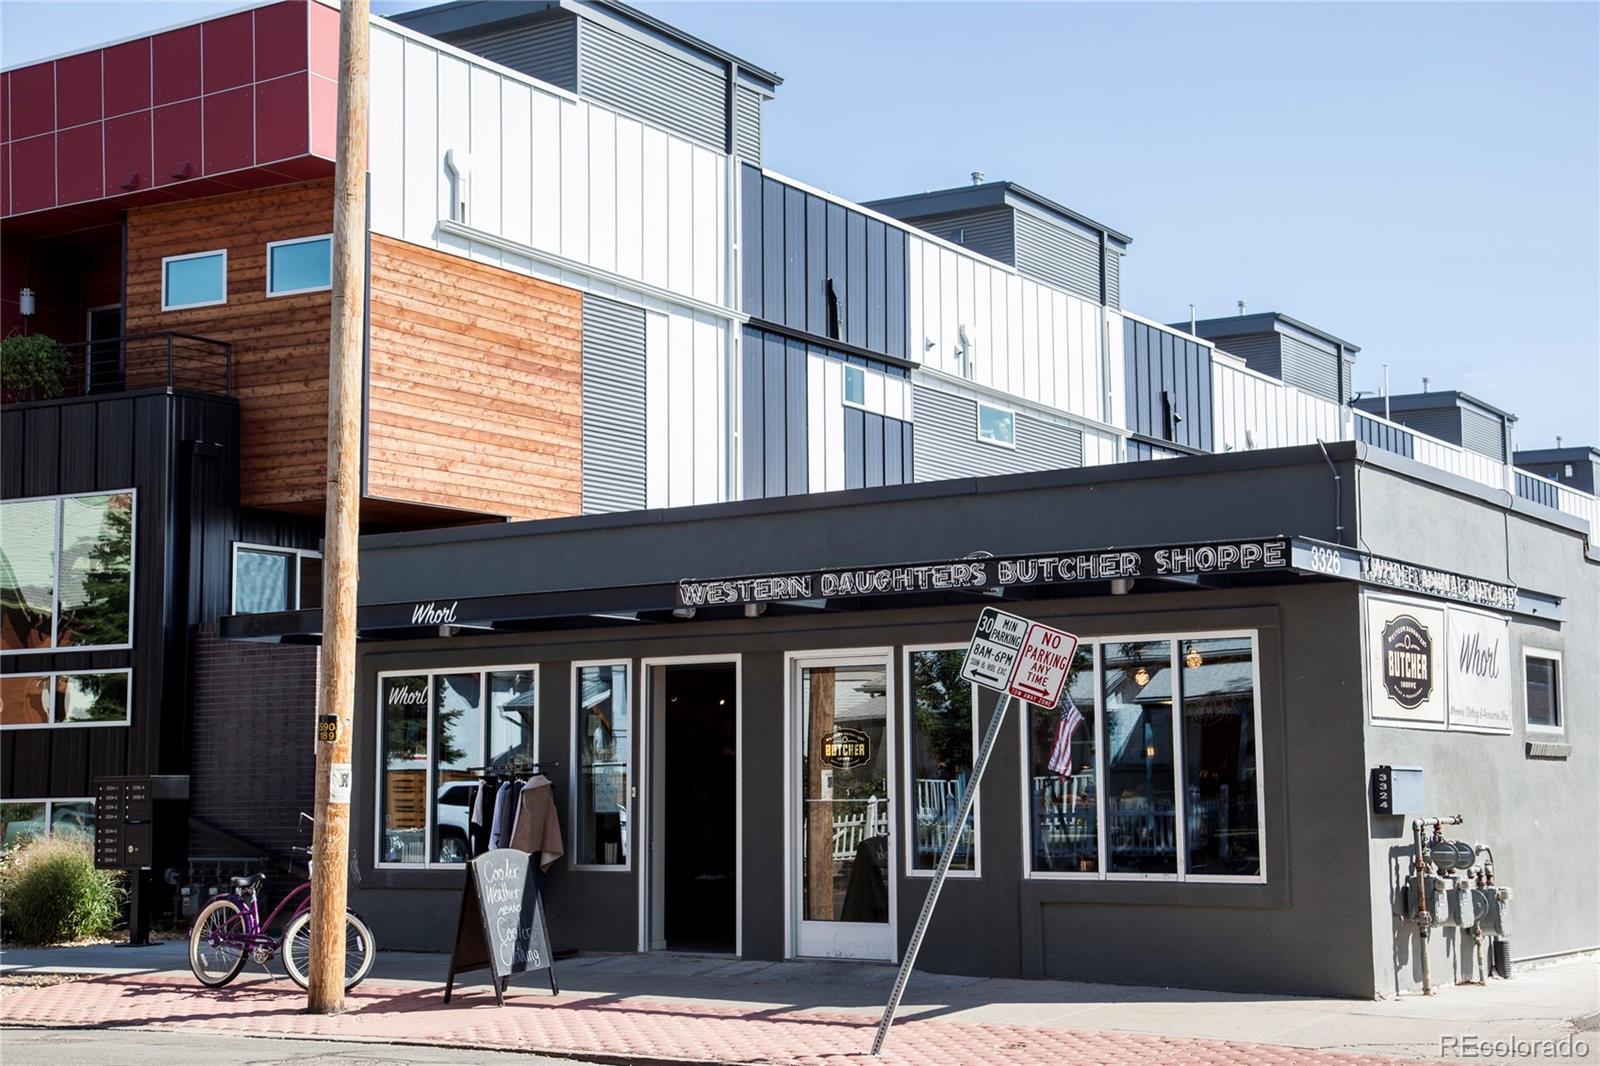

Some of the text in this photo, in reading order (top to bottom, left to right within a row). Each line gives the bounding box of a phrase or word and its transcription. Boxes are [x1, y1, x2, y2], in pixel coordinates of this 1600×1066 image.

[1311, 546, 1341, 574] 3326
[680, 542, 1286, 605] WESTERN DAUGHTERS BUTCHER SHOPPE
[412, 601, 458, 625] Whorl
[979, 616, 995, 634] 30
[1002, 619, 1019, 632] MIN
[991, 628, 1021, 647] PARKING
[1041, 631, 1062, 649] NO
[973, 643, 1014, 666] 8AM-6PM
[1024, 645, 1067, 670] PARKING
[1388, 650, 1428, 680] BUTCHER
[1460, 632, 1499, 679] Whorl
[1026, 671, 1049, 687] TIME
[1031, 662, 1051, 675] ANY
[388, 685, 429, 705] Whorl
[1039, 697, 1052, 706] ZONE
[825, 744, 865, 756] BUTCHER
[1379, 774, 1389, 808] 3324
[484, 858, 519, 883] Cooler
[485, 883, 520, 904] Weather
